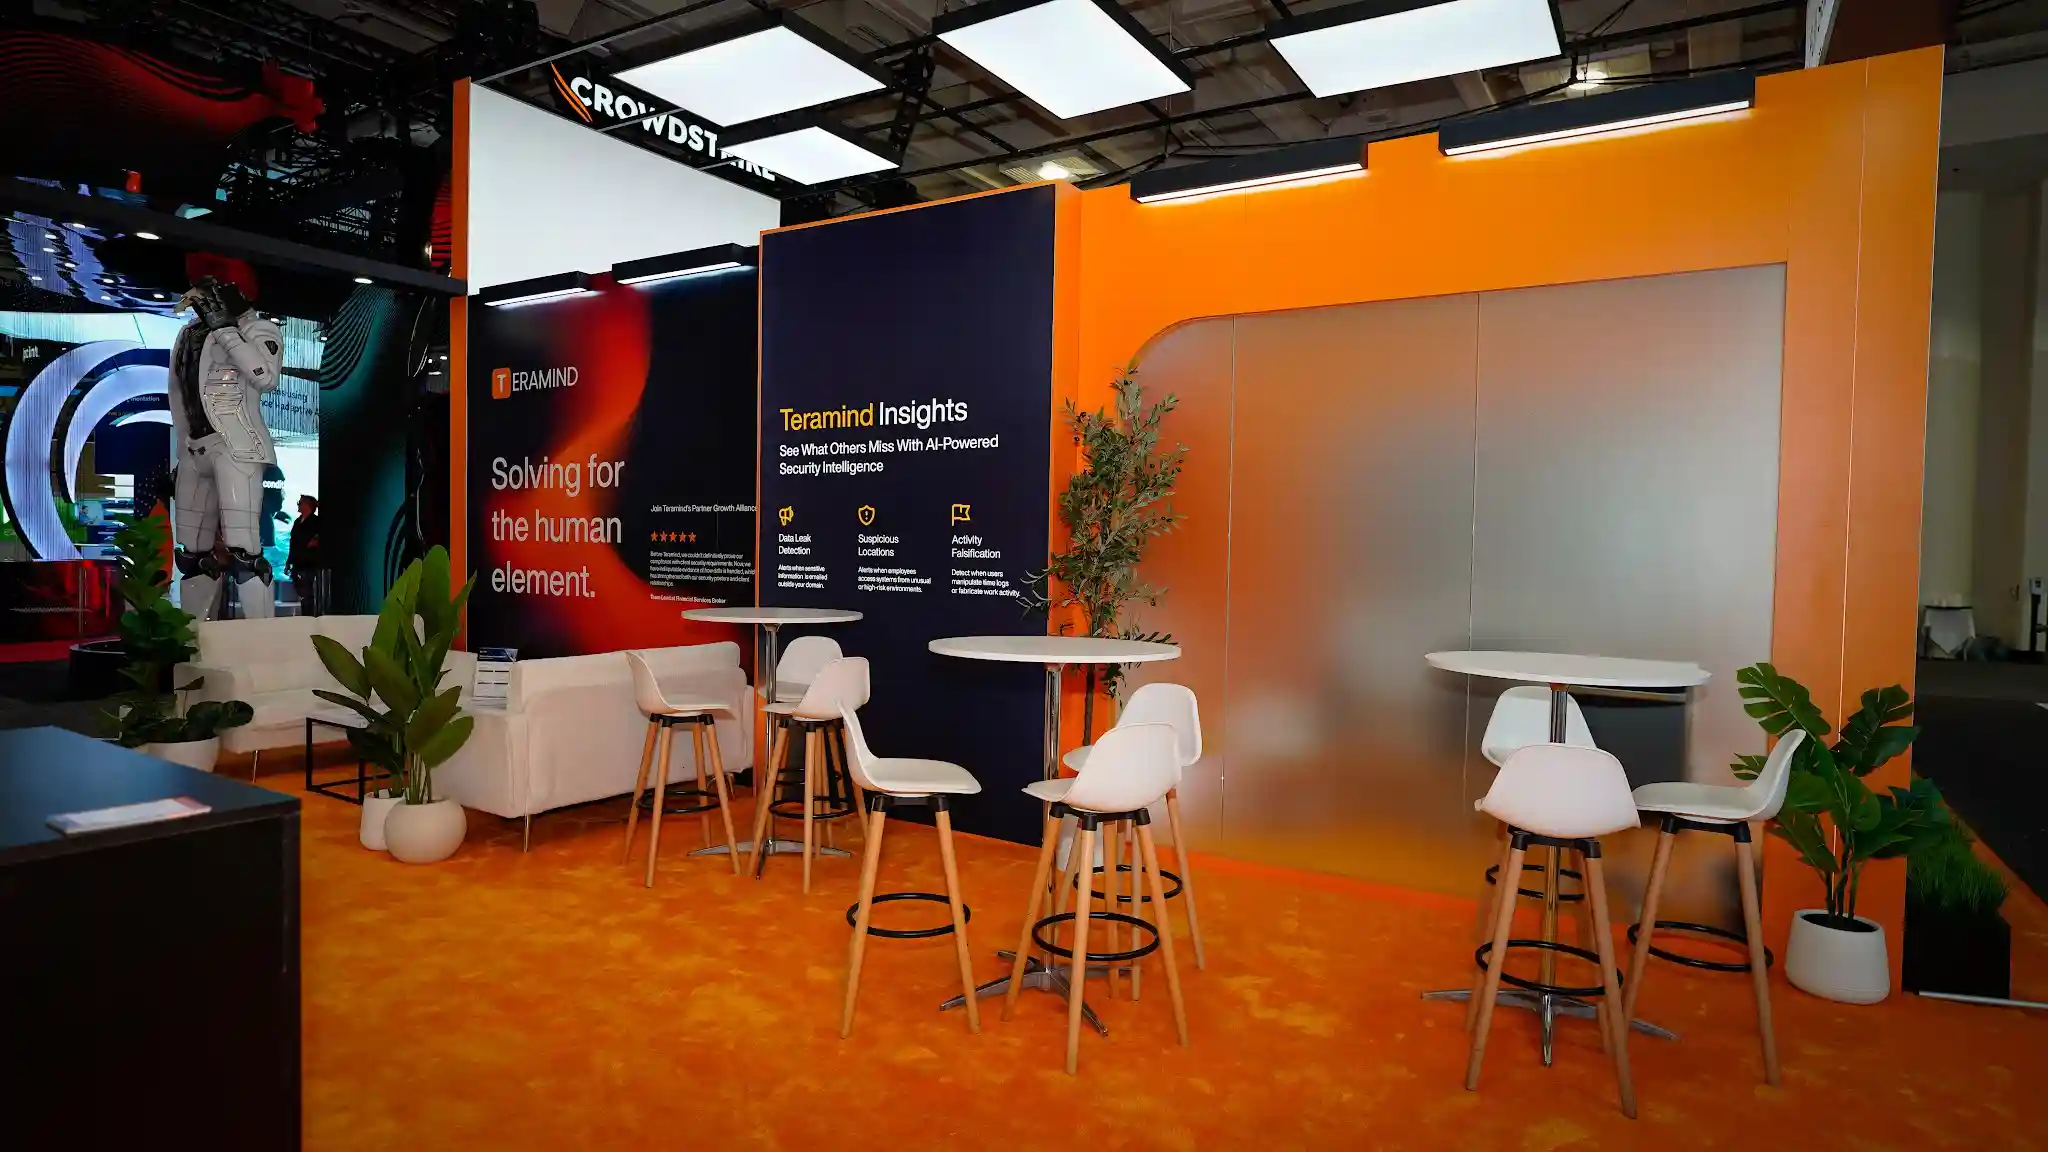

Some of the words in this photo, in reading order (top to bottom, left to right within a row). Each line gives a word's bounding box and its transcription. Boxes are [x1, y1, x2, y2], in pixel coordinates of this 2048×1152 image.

[570, 76, 775, 181] CROWDST
[779, 403, 874, 431] Teramind
[879, 398, 968, 430] Insights
[779, 444, 799, 457] See
[801, 443, 829, 456] What
[830, 440, 867, 455] Others
[868, 440, 895, 453] Miss
[896, 437, 924, 452] With
[925, 434, 999, 451] AI-Powered
[779, 461, 821, 477] Security
[822, 460, 884, 476] Intelligence
[491, 456, 581, 497] Solving
[587, 453, 625, 488] for
[713, 504, 734, 512] Growth
[491, 509, 529, 542] the
[535, 509, 622, 543] human
[778, 533, 794, 543] Data
[795, 533, 811, 543] Leak
[858, 533, 899, 545] Suspicious
[951, 534, 983, 546] Activity
[778, 546, 811, 555] Detection
[858, 547, 894, 556] Locations
[951, 548, 1001, 558] Falsification
[491, 561, 596, 598] element.
[996, 579, 1009, 588] logs
